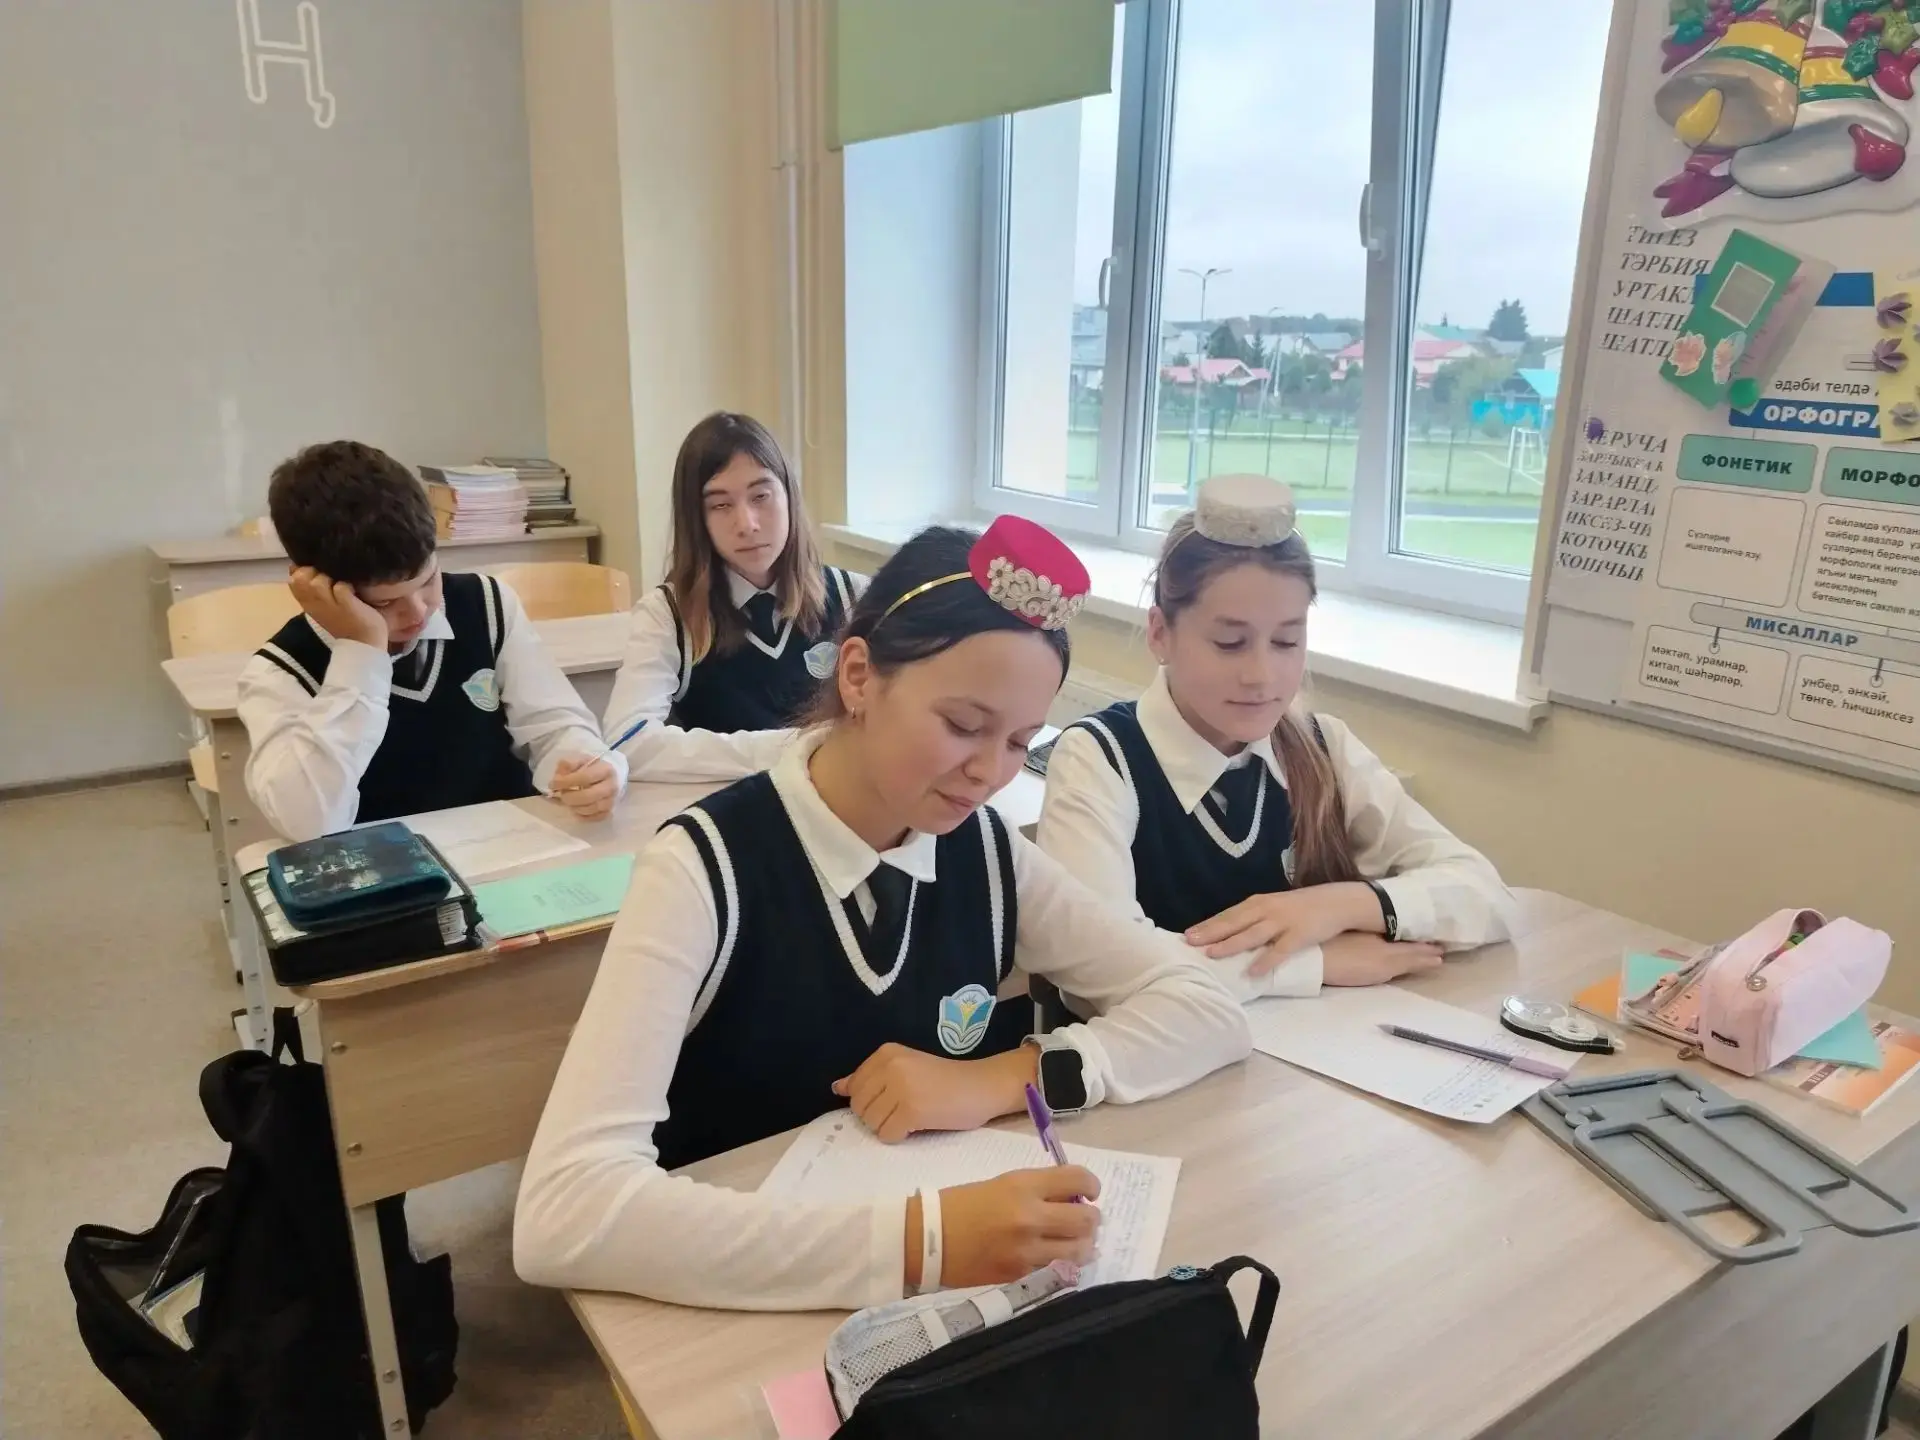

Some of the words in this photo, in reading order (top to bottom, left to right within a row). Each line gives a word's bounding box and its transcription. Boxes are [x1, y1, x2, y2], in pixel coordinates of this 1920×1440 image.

[1620, 252, 1711, 276] ТӘРБИЯ
[1775, 377, 1820, 392] әдәби
[1825, 382, 1871, 396] телдә
[1702, 454, 1792, 475] ФОНЕТИК
[1841, 467, 1920, 488] МОРФО
[1820, 555, 1881, 571] морфологик
[1746, 616, 1859, 647] МИСАЛЛАР
[1646, 674, 1680, 687] икмәк
[1841, 699, 1914, 724] һичшиксез
